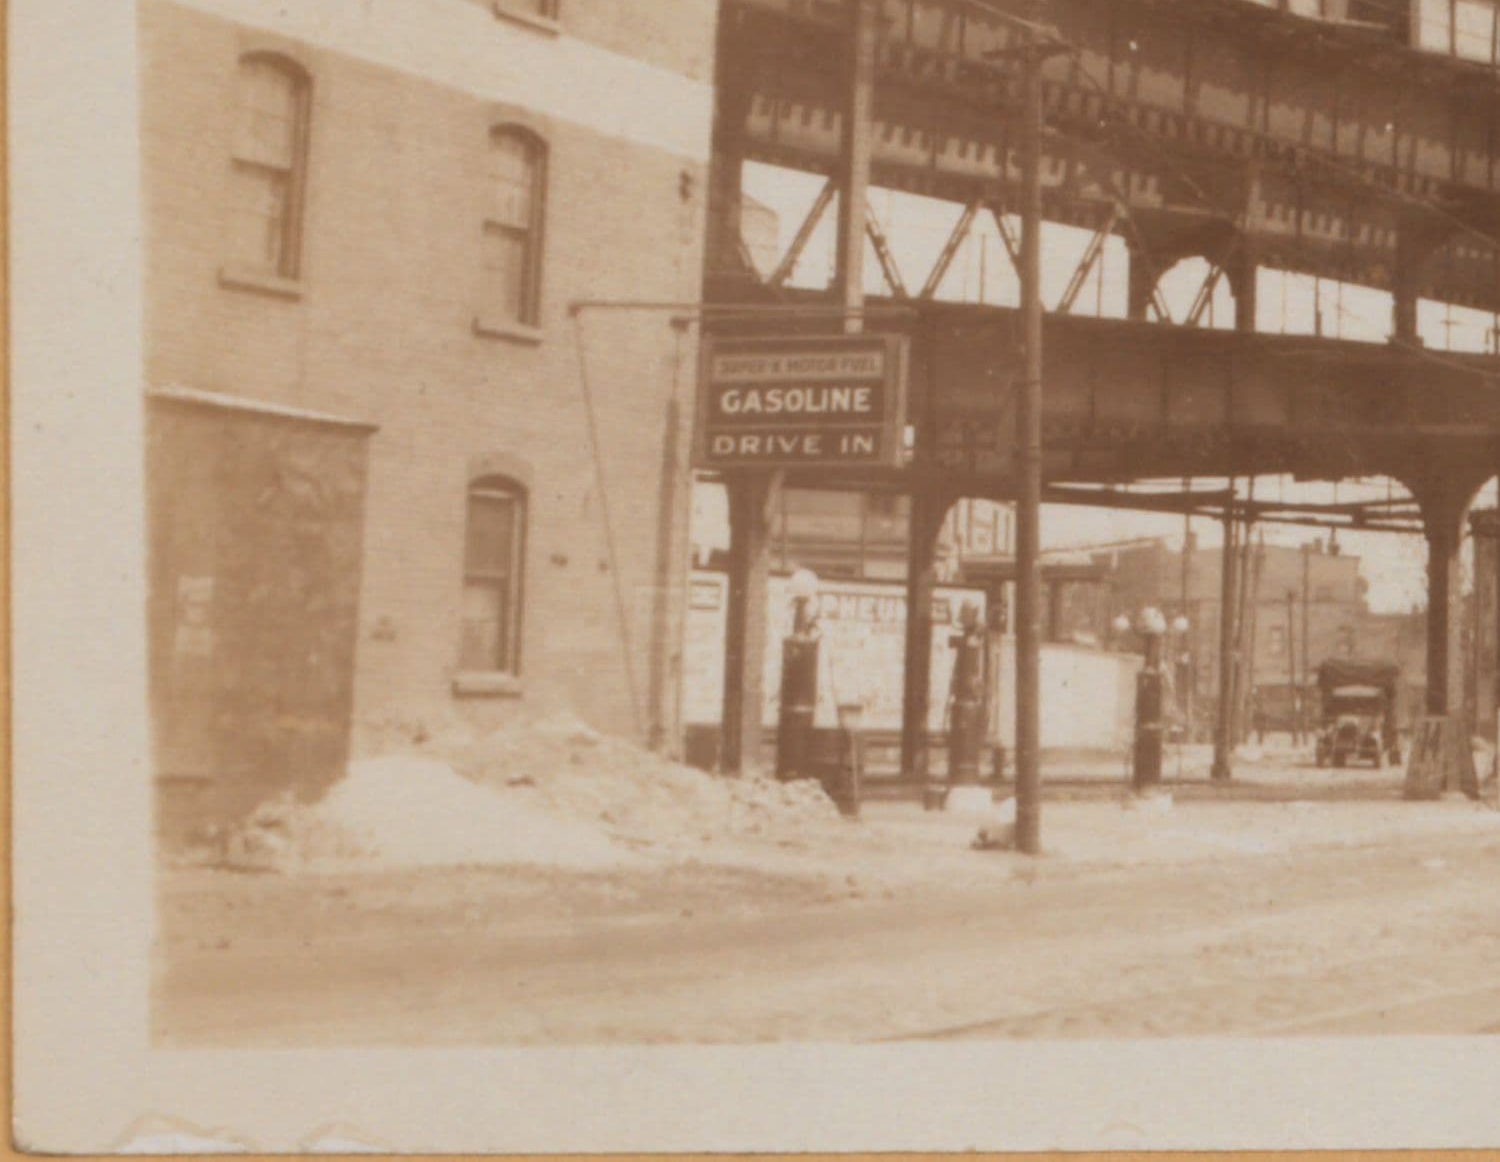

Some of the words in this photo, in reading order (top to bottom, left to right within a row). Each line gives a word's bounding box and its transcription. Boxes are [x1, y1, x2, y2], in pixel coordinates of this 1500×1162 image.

[720, 387, 872, 413] GASOLINE
[712, 434, 822, 455] DRIVE
[841, 434, 874, 454] IN
